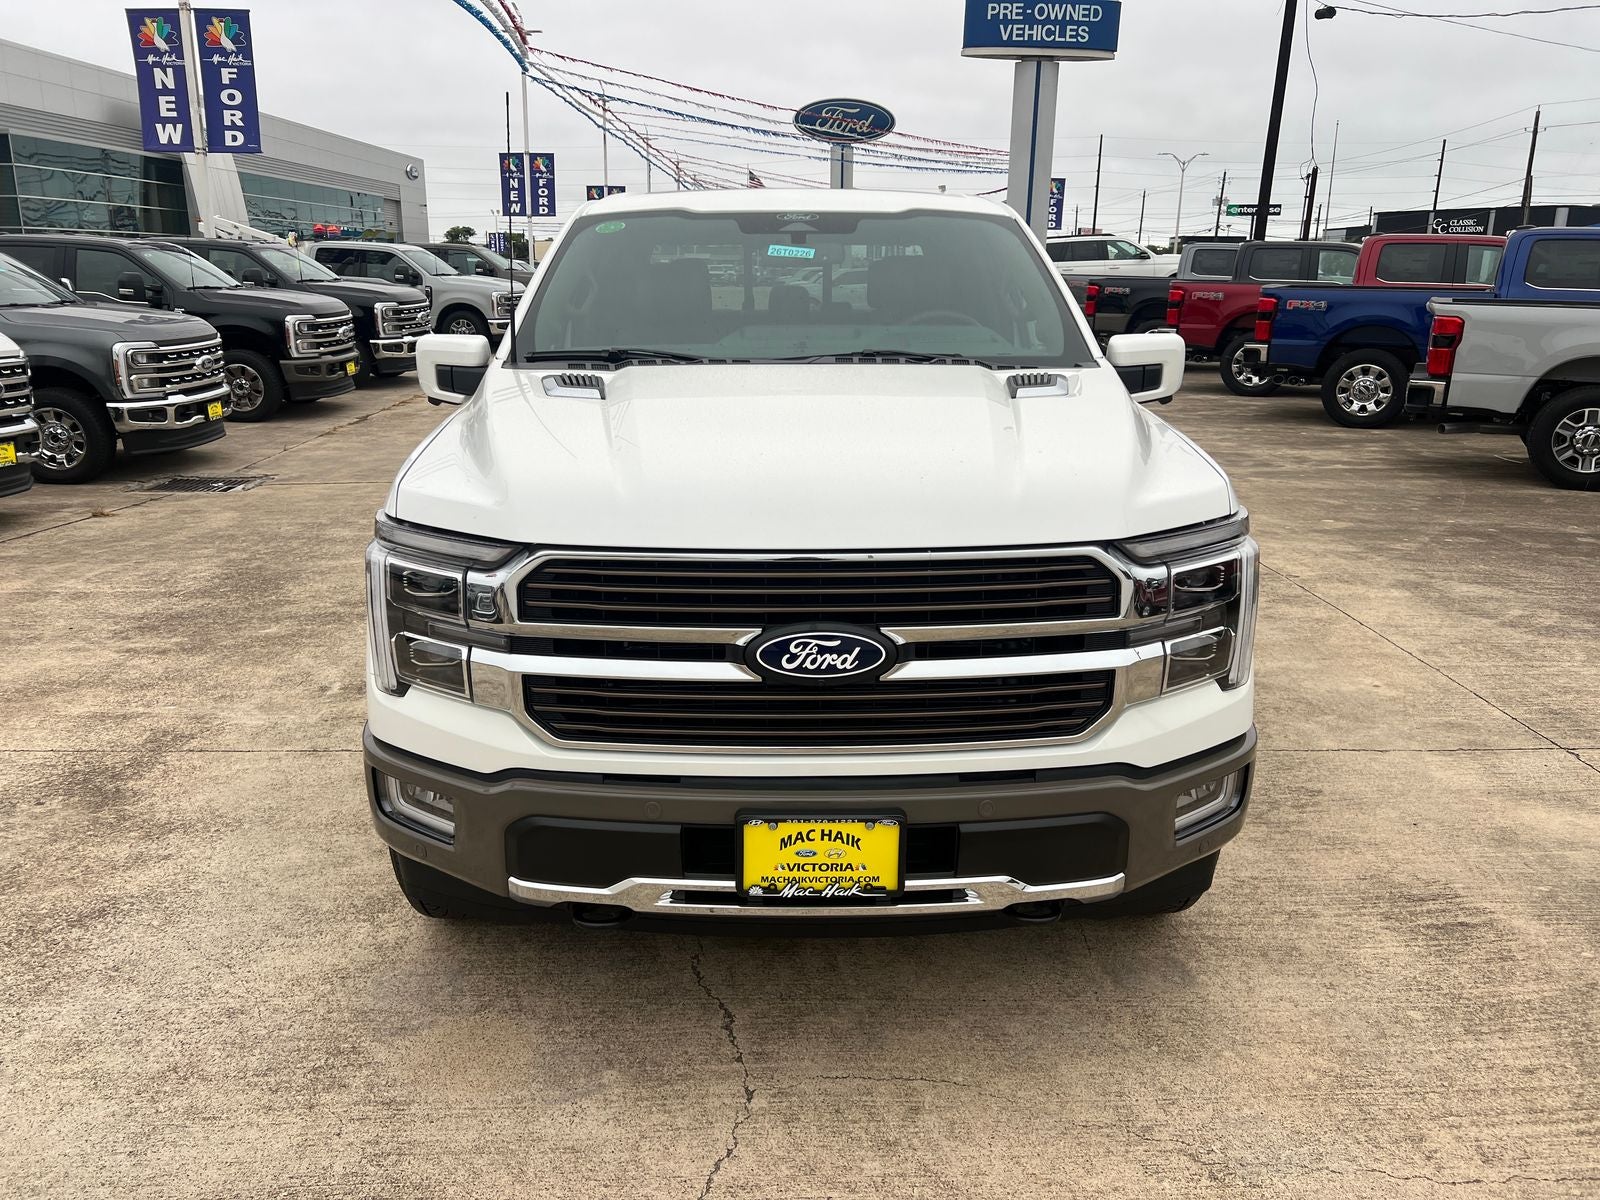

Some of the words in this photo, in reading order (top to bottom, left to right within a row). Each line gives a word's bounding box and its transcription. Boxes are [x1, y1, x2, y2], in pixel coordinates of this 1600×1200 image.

[1000, 24, 1089, 43] VEHICLES
[153, 67, 183, 145] NEW
[220, 67, 245, 147] FORD
[815, 106, 875, 133] Ford
[507, 178, 520, 214] NEW
[537, 178, 549, 214] FORD
[1048, 198, 1057, 228] FORD
[1228, 206, 1281, 214] enterse
[1448, 225, 1485, 233] COLLISION
[770, 247, 812, 257] 26T0226
[1191, 291, 1225, 300] FX4
[1286, 300, 1328, 311] FX4
[781, 638, 861, 670] Ford
[779, 829, 816, 851] MAC
[820, 829, 862, 851] HAIK
[785, 862, 855, 872] VICTORIA
[760, 875, 880, 884] MACHAIKVICTORIA.COM
[780, 883, 819, 898] Mac
[820, 883, 864, 898] Haik
